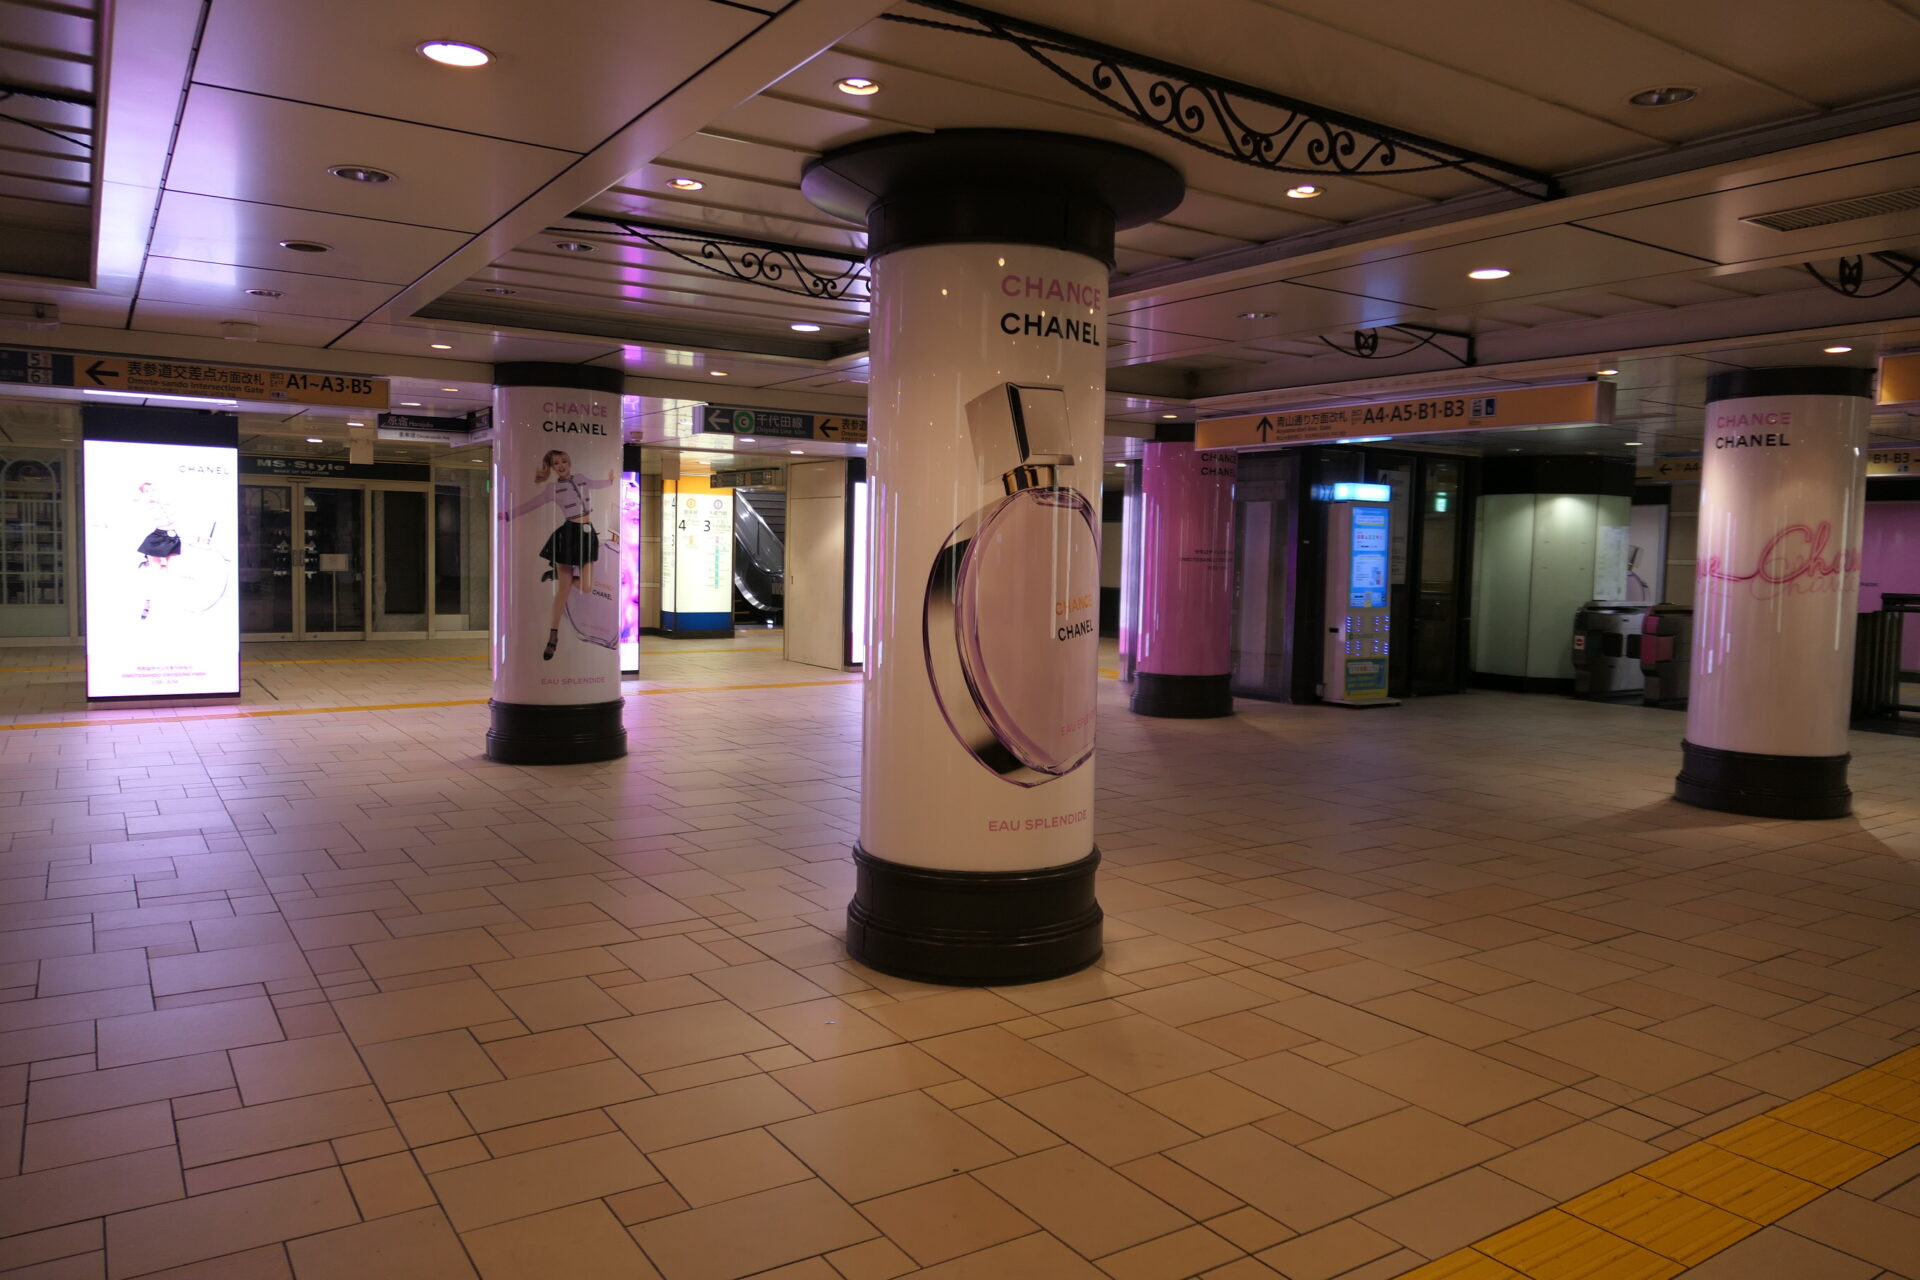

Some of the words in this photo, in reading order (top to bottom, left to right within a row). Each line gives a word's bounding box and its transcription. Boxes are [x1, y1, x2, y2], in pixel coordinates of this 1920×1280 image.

[1001, 274, 1101, 311] CHANCE
[1000, 312, 1100, 346] CHANEL
[127, 360, 264, 386] 表参道交差点方面改札
[543, 402, 608, 417] CHANCE
[756, 414, 803, 428] 千代田線
[1717, 411, 1792, 428] CHANCE
[543, 421, 607, 436] CHANEL
[1715, 434, 1791, 449] CHANEL
[179, 465, 229, 475] CHANEL
[678, 519, 686, 532] 4
[703, 519, 711, 532] 3
[1056, 593, 1093, 616] CHANCE
[1058, 618, 1093, 641] CHANEL
[989, 820, 1020, 832] EAU
[1025, 809, 1088, 831] SPLENDIDE
